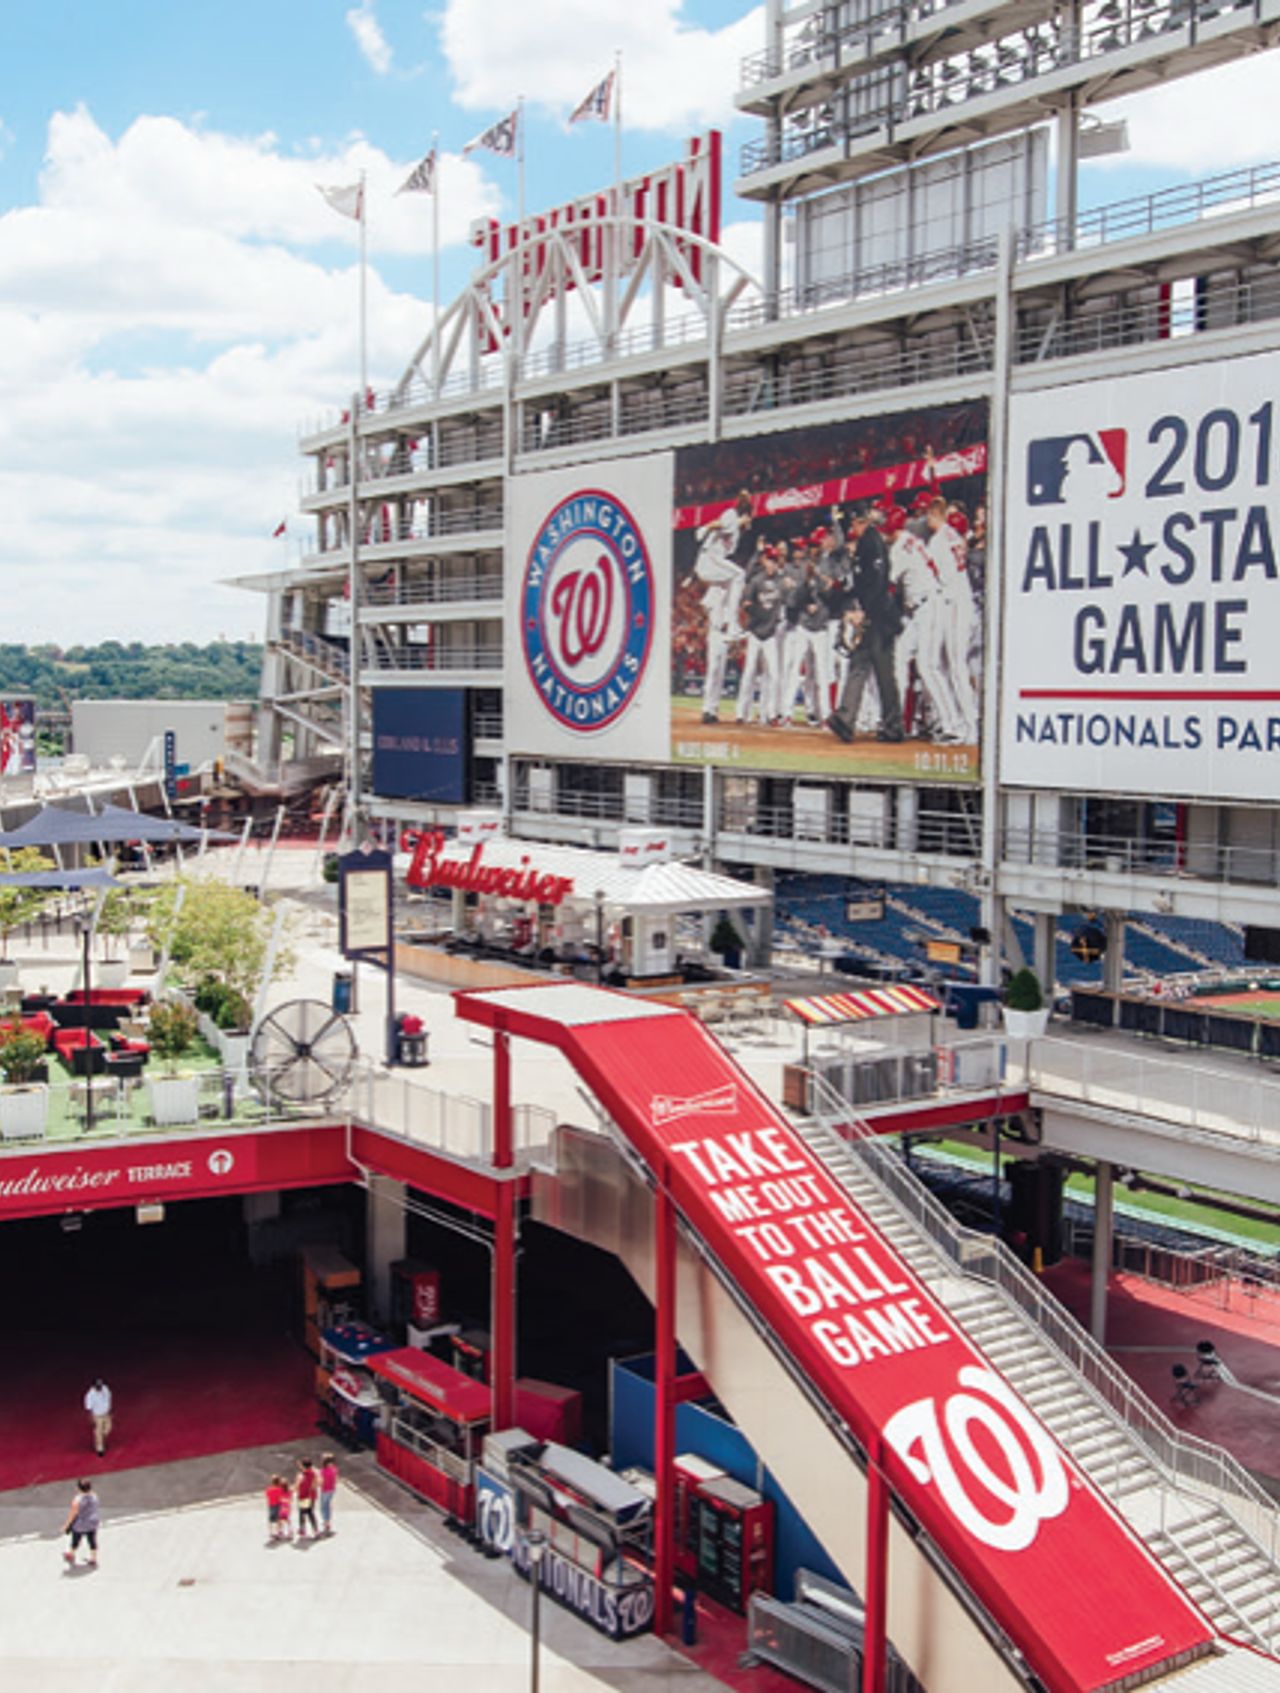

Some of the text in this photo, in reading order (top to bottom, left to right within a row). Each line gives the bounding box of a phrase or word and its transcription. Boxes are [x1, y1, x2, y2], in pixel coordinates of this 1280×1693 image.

[527, 499, 646, 587] WASHINGTON
[1021, 520, 1114, 593] ALL
[1073, 598, 1249, 676] GAME
[527, 651, 640, 720] NATIONALS
[1016, 712, 1203, 750] NATIONALS
[400, 828, 575, 906] Budweiser
[126, 1160, 193, 1184] TERRACE
[670, 1126, 806, 1186] TAKE
[707, 1174, 830, 1224] ME OUT
[734, 1208, 867, 1261] TO THE
[764, 1246, 910, 1317] BALL
[810, 1298, 953, 1368] GAME
[511, 1541, 618, 1633] NIONALS
